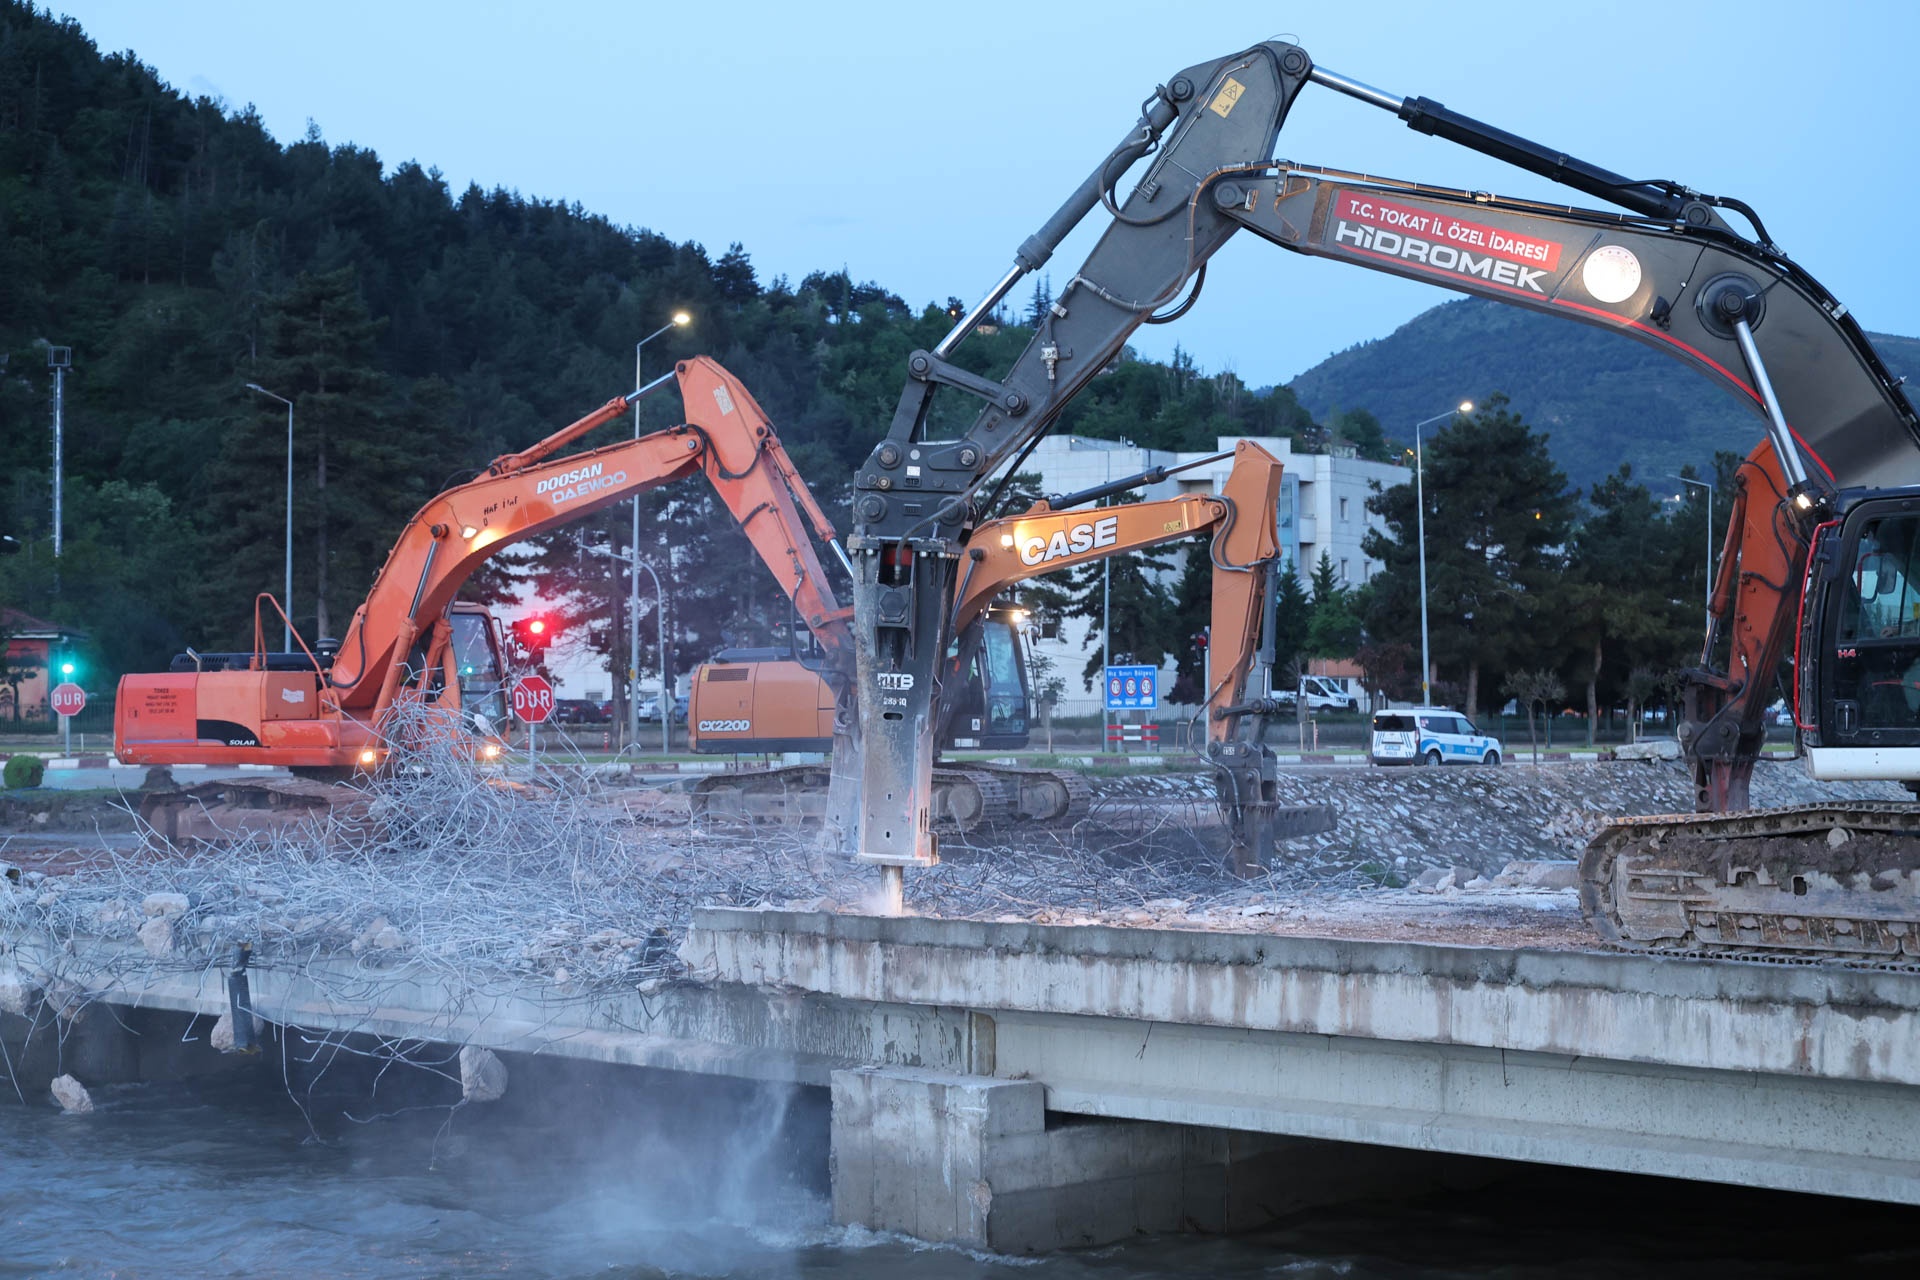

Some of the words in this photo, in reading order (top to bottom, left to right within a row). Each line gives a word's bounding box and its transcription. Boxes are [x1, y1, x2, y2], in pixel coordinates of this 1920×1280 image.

[1350, 200, 1375, 220] T.C.
[1379, 208, 1430, 234] TOKAT
[1431, 218, 1444, 237] İL
[1448, 221, 1486, 247] ÖZEL
[1488, 231, 1550, 262] İDARESİ
[1335, 220, 1549, 293] HİDROMEK
[536, 462, 603, 495] DOOSAN
[552, 471, 627, 504] DAEWOO
[1020, 515, 1119, 566] CASE
[54, 693, 82, 706] DUR
[515, 689, 551, 710] DUR
[699, 720, 750, 732] CX220D
